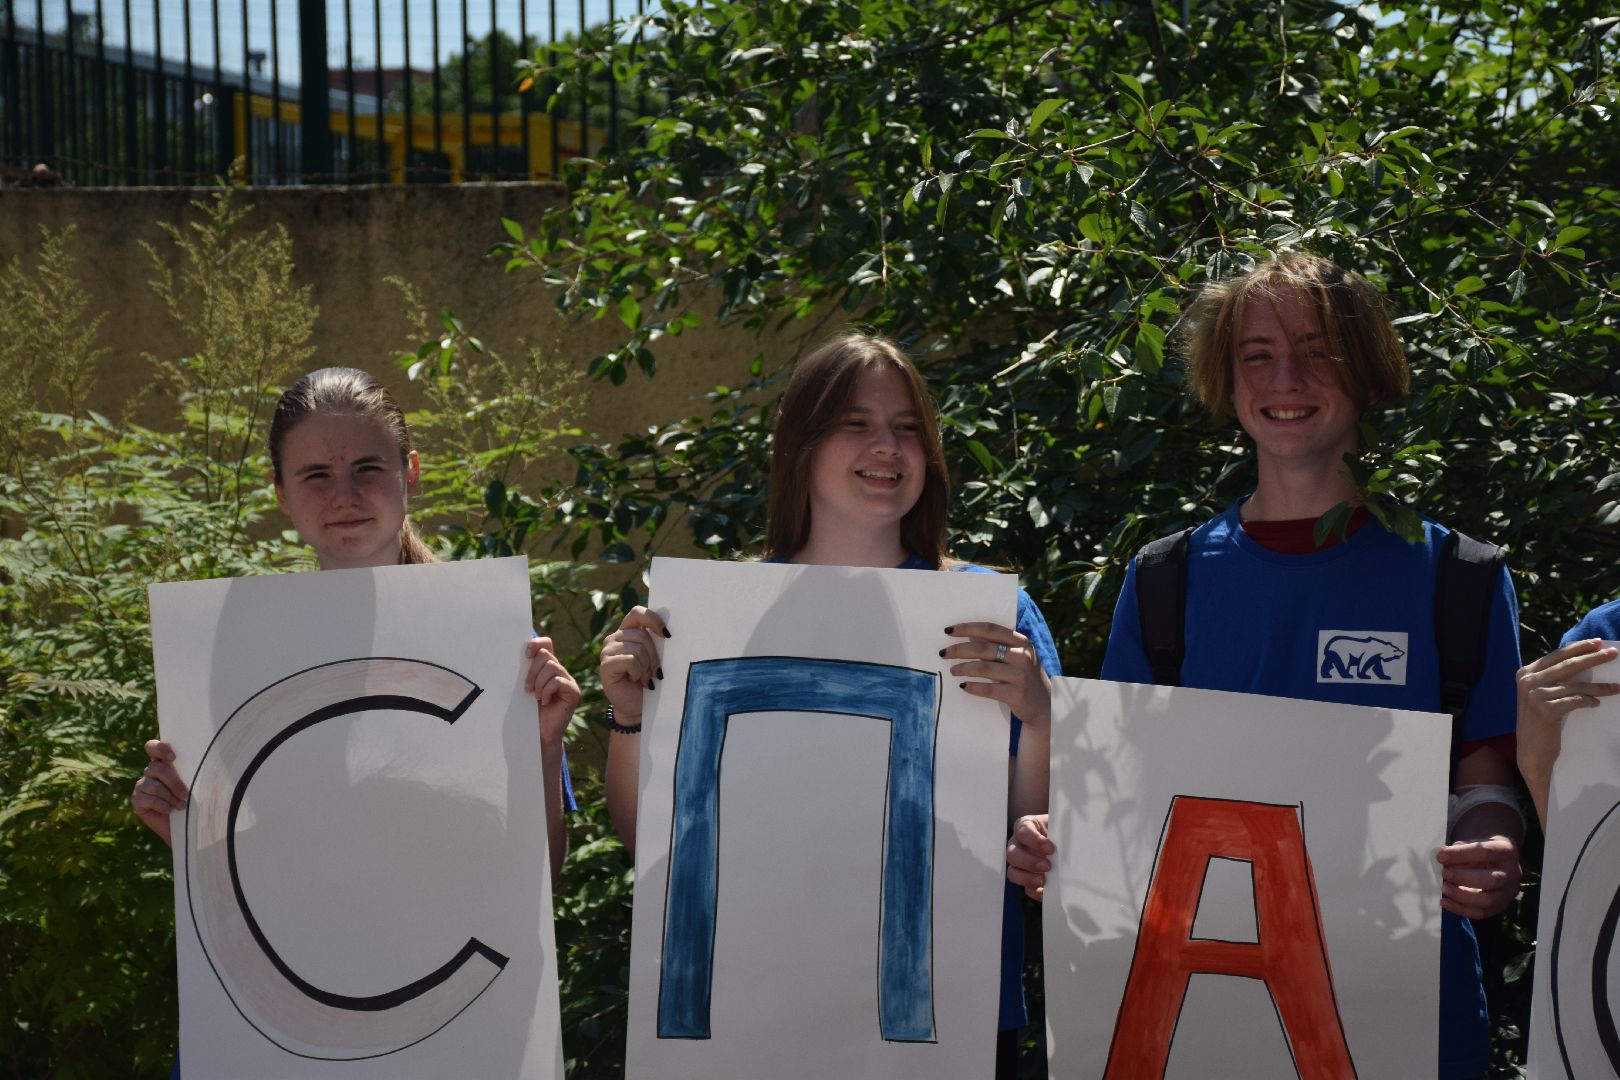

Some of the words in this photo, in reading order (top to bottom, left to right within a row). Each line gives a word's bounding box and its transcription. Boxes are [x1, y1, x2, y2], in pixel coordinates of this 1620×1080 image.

[185, 656, 510, 1061] С
[656, 655, 942, 1044] П
[1102, 794, 1358, 1080] А
